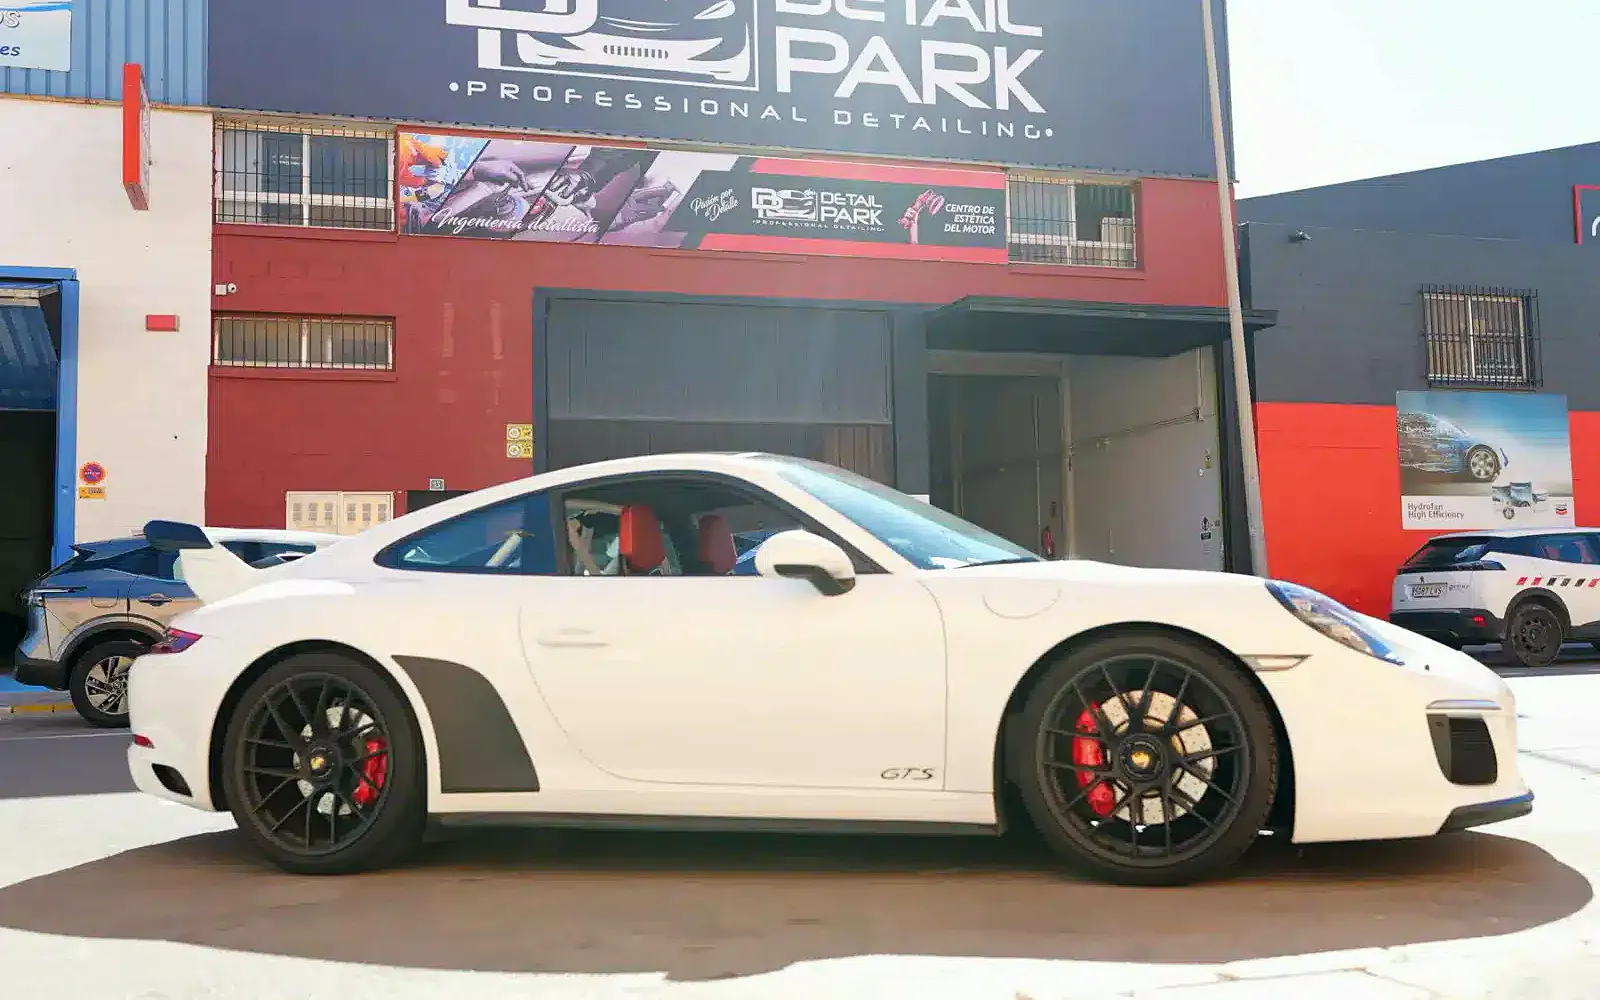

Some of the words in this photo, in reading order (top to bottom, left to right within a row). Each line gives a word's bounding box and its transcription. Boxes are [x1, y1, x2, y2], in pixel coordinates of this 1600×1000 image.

[775, 26, 1047, 114] PARK
[466, 80, 808, 123] PROFESSIONAL
[833, 109, 1041, 139] DETAILING
[820, 191, 883, 208] DETAIL
[820, 206, 885, 226] PARK
[945, 203, 981, 214] CENTRO
[982, 206, 995, 215] DE
[527, 215, 600, 233] detallista
[944, 224, 961, 233] DEL
[962, 225, 996, 235] MOTOR
[1407, 502, 1444, 512] Hydrofan
[1408, 511, 1427, 520] High
[1428, 511, 1465, 520] Efficiency
[880, 767, 935, 781] GTS
